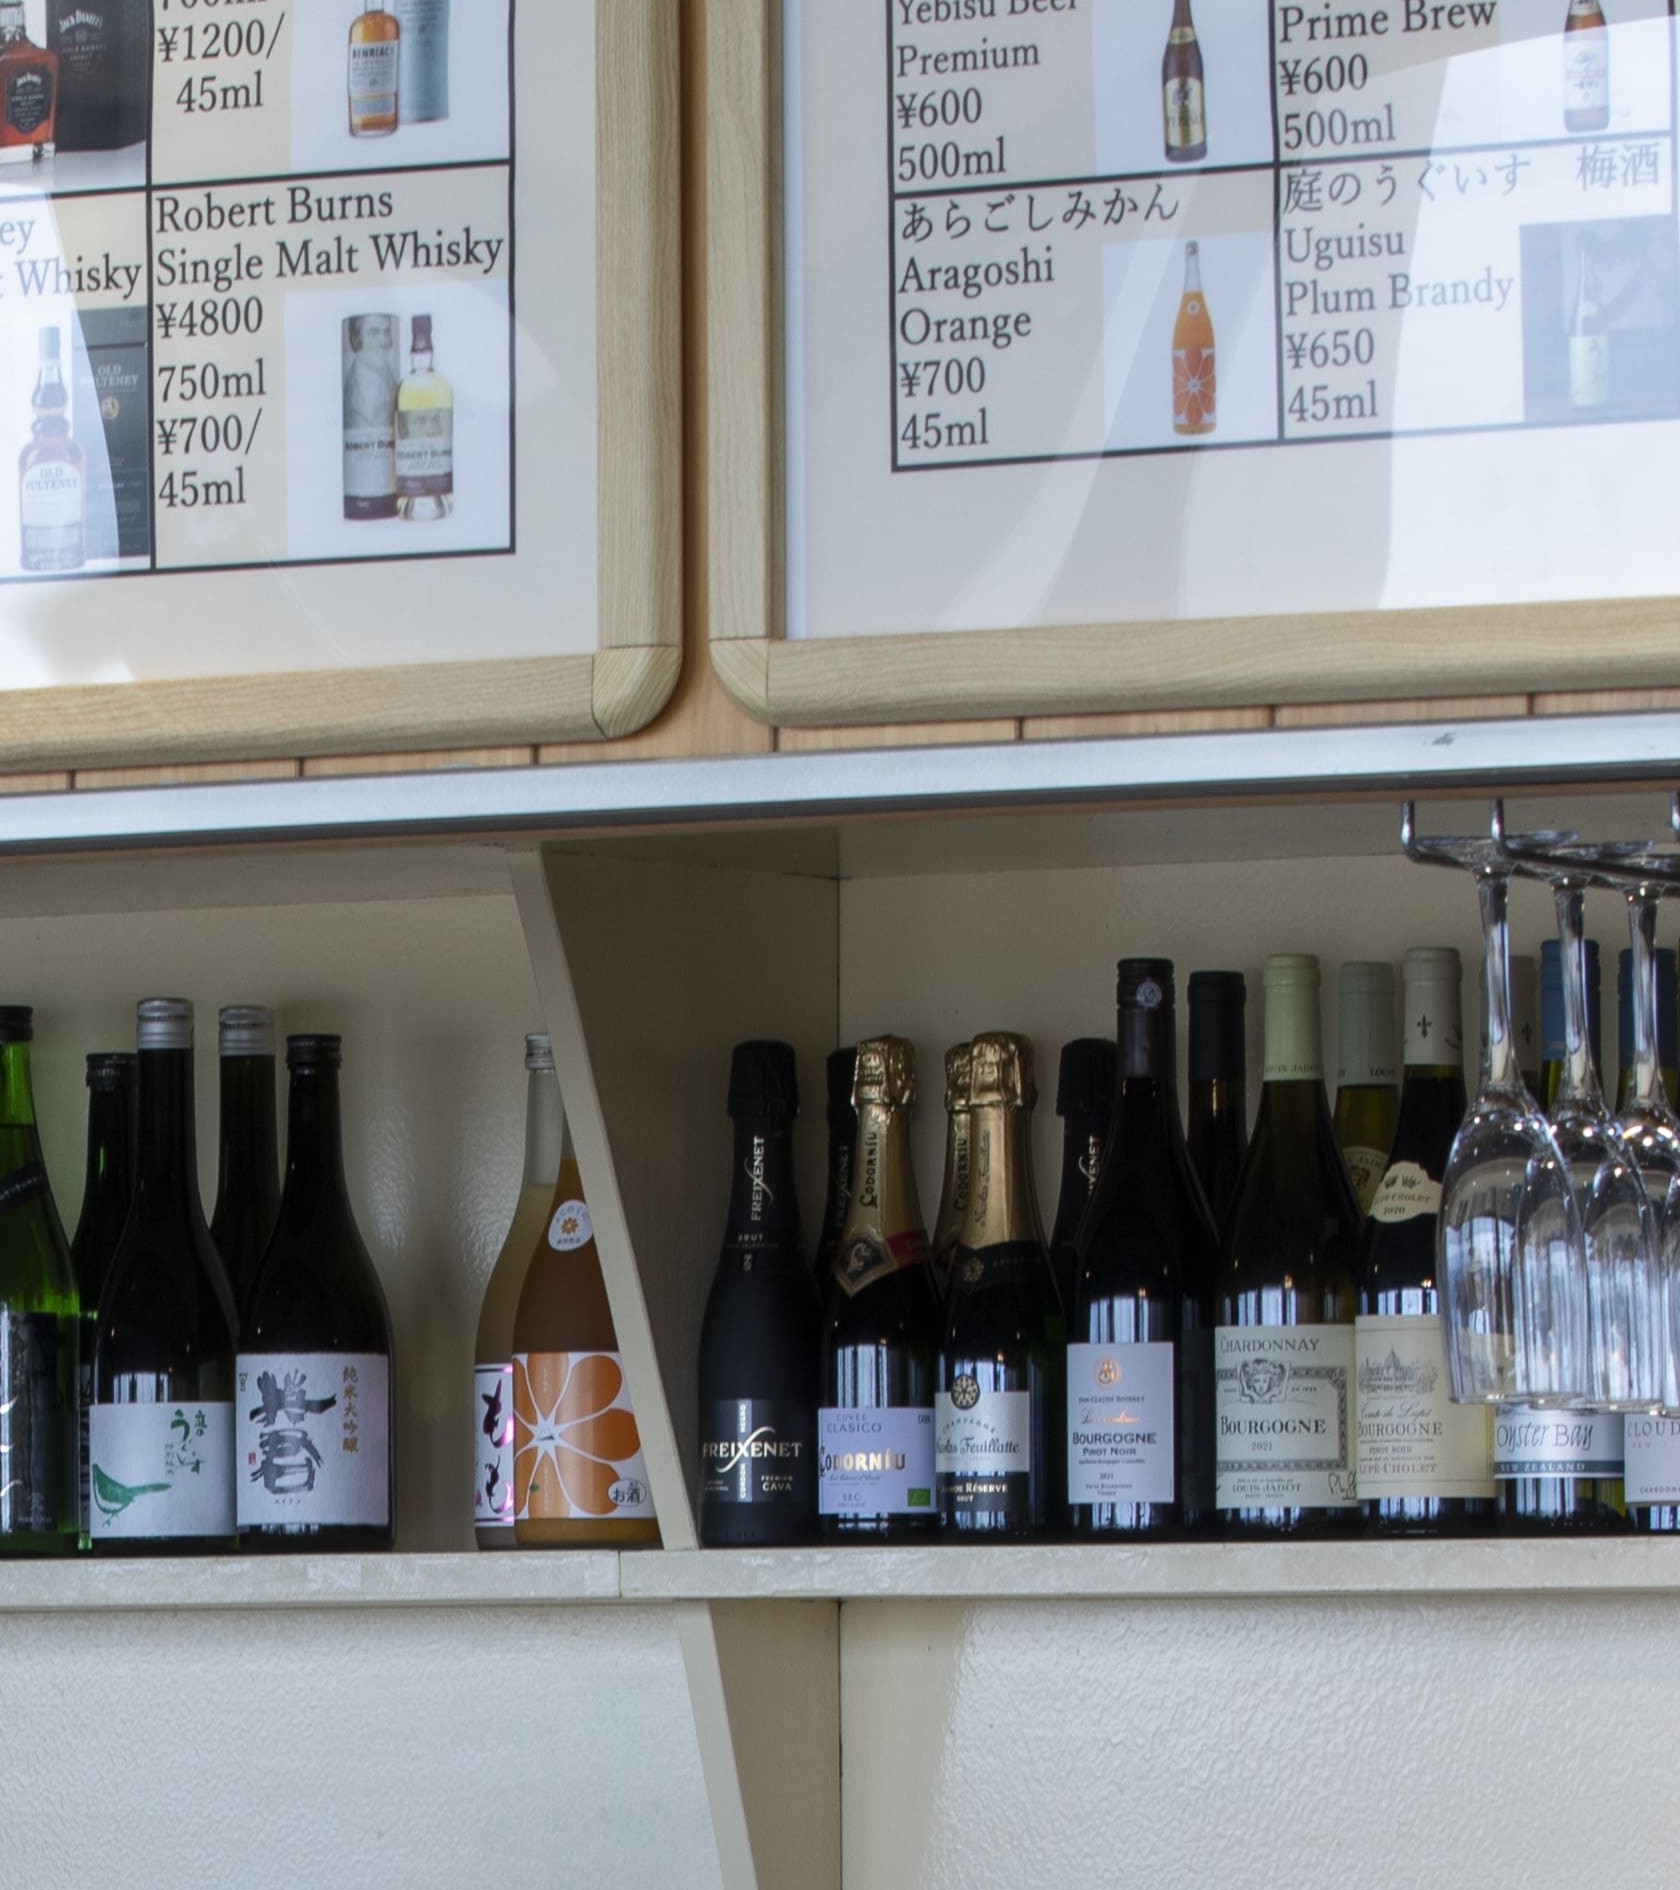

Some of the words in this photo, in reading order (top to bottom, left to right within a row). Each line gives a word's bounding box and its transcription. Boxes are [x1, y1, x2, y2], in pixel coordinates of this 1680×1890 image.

[158, 12, 284, 62] ¥1200/
[1279, 3, 1388, 43] Prime
[1403, 0, 1496, 32] Brew
[897, 37, 1039, 77] Premium
[1279, 54, 1368, 95] ¥600
[177, 70, 262, 112] 45ml
[896, 88, 982, 128] ¥600
[1284, 103, 1395, 150] 500ml
[899, 136, 1005, 181] 500ml
[1282, 150, 1532, 216] 庭のうぐいす
[1576, 142, 1660, 192] 梅酒
[156, 192, 275, 233] Robert
[288, 187, 392, 223] Burns
[902, 184, 1178, 242] あらごしみかん
[157, 243, 262, 292] Single
[276, 236, 358, 277] Malt
[370, 226, 503, 274] Whisky
[1284, 223, 1404, 271] Uguisu
[18, 253, 141, 300] Whisky
[898, 245, 1054, 298] Aragoshi
[1286, 279, 1375, 316] Plum
[1388, 266, 1513, 311] Brandy
[156, 297, 262, 338] ¥4800
[900, 308, 1031, 349] Orange
[1285, 328, 1374, 369] ¥650
[158, 358, 265, 402] 750ml
[900, 357, 985, 397] ¥700
[1288, 380, 1378, 422] 45ml
[157, 408, 262, 454] ¥700/
[901, 408, 988, 449] 45ml
[159, 466, 245, 507] 45ml
[1220, 1336, 1319, 1352] CHARDONNAY
[1072, 1432, 1156, 1445] BOURGOGNE
[1220, 1416, 1326, 1435] BOURGOGNE
[1496, 1423, 1548, 1452] Oyster
[1553, 1423, 1593, 1451] Bay
[703, 1442, 802, 1459] FREIXENET
[1082, 1447, 1108, 1456] PINOT
[1110, 1447, 1136, 1456] NOIR
